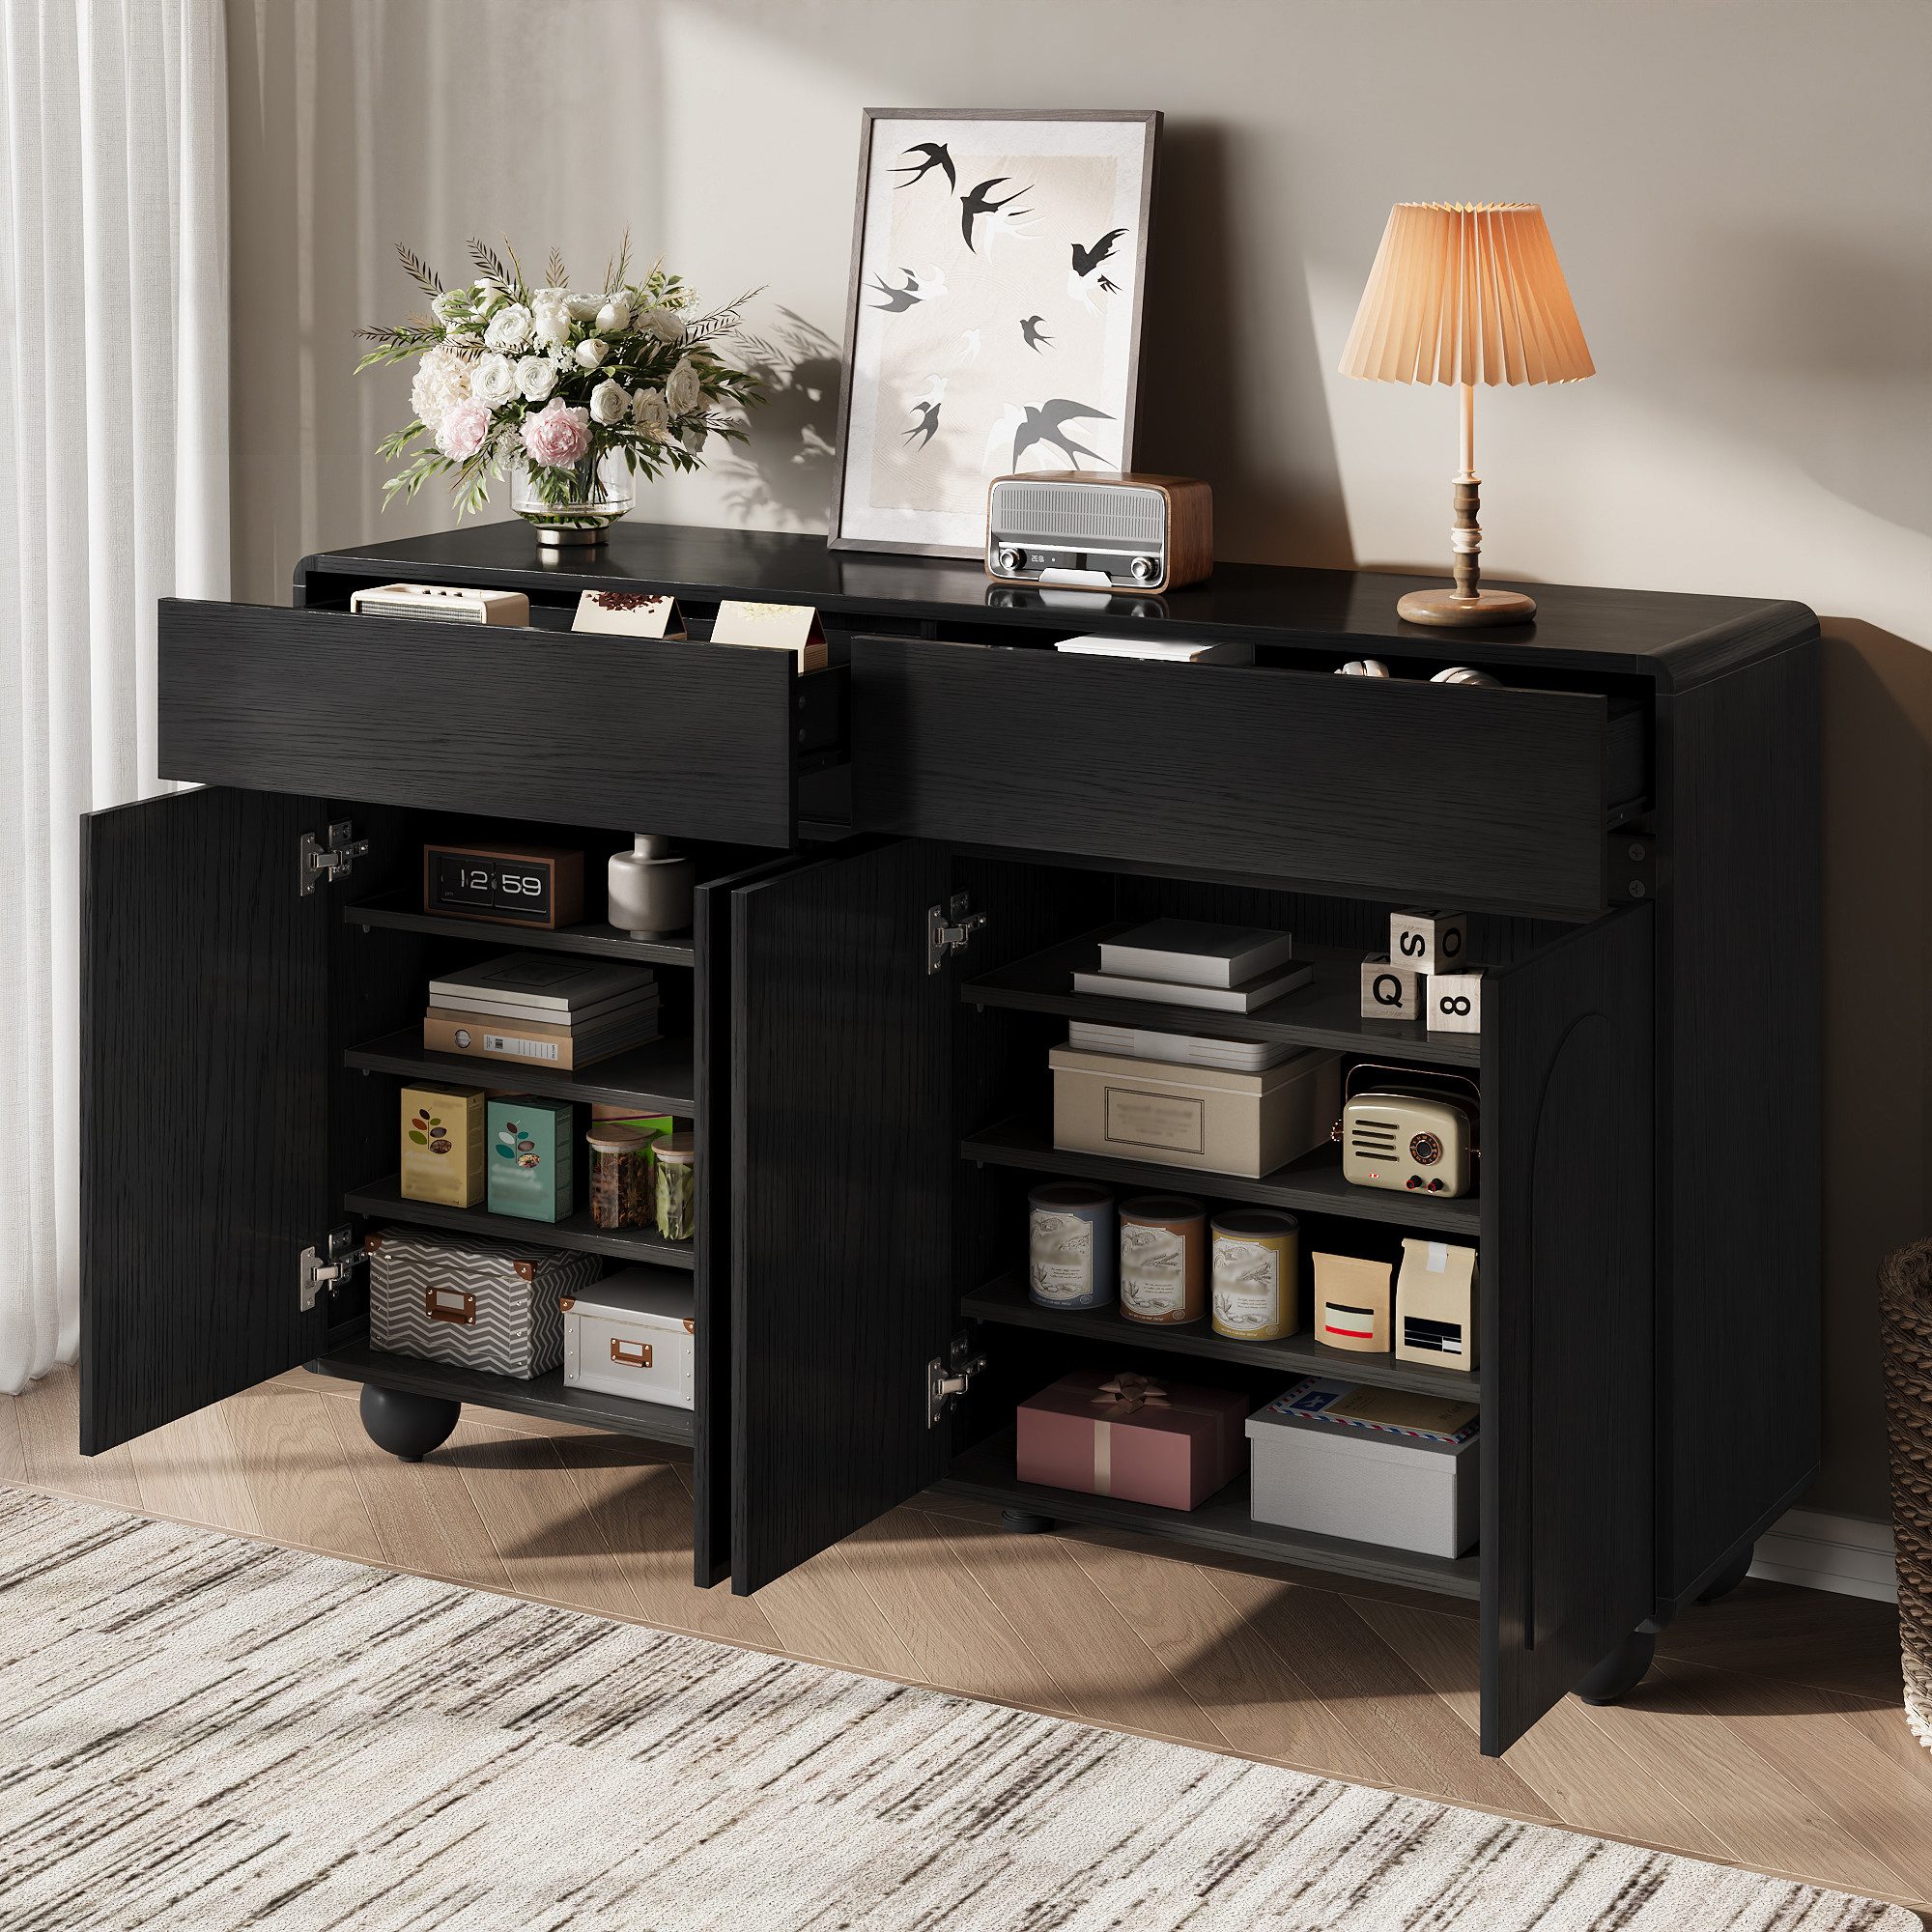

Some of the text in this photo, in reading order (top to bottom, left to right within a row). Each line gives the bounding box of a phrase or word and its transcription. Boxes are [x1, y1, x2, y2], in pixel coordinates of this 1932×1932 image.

[1400, 930, 1426, 958] S
[1372, 974, 1404, 1009] Q
[1439, 995, 1471, 1016] 8
